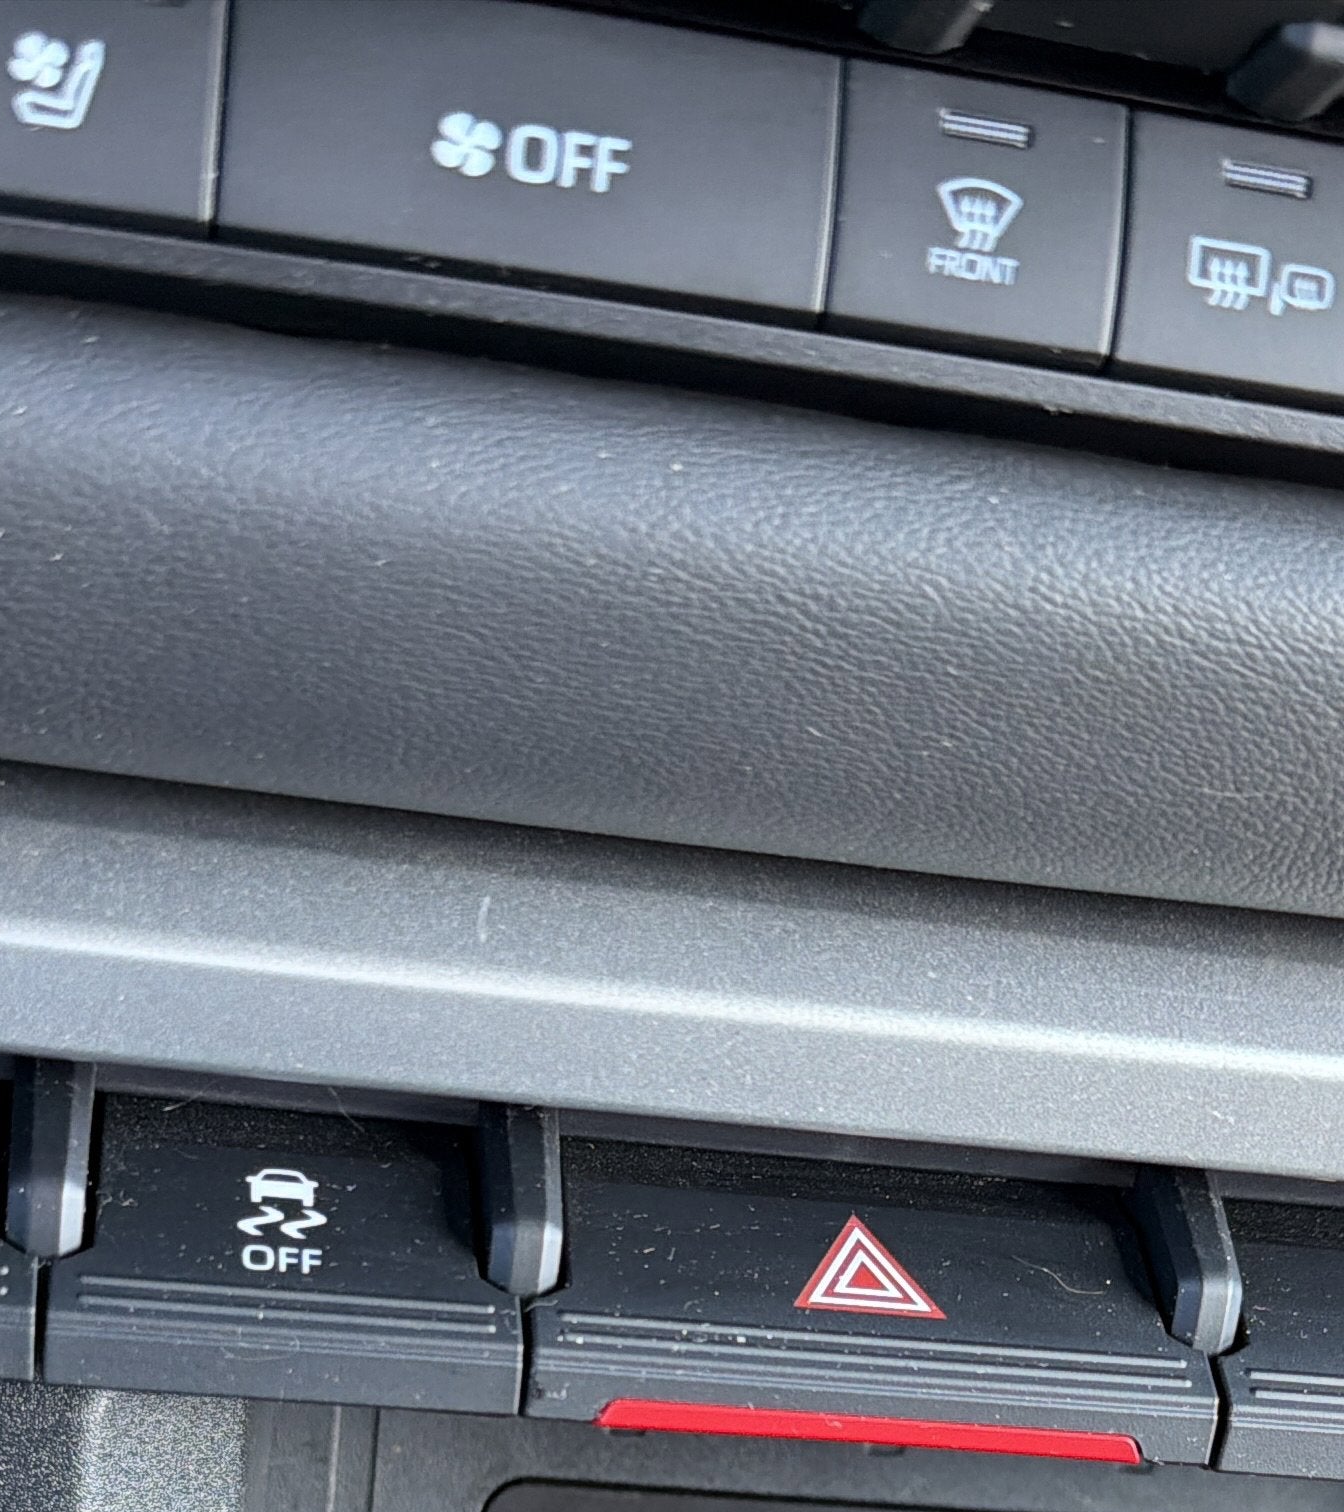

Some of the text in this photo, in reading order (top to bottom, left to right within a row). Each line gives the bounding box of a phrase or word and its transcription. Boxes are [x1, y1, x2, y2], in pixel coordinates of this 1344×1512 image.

[507, 123, 634, 193] OFF
[927, 246, 1020, 287] FRONT
[242, 1244, 323, 1275] OFF
